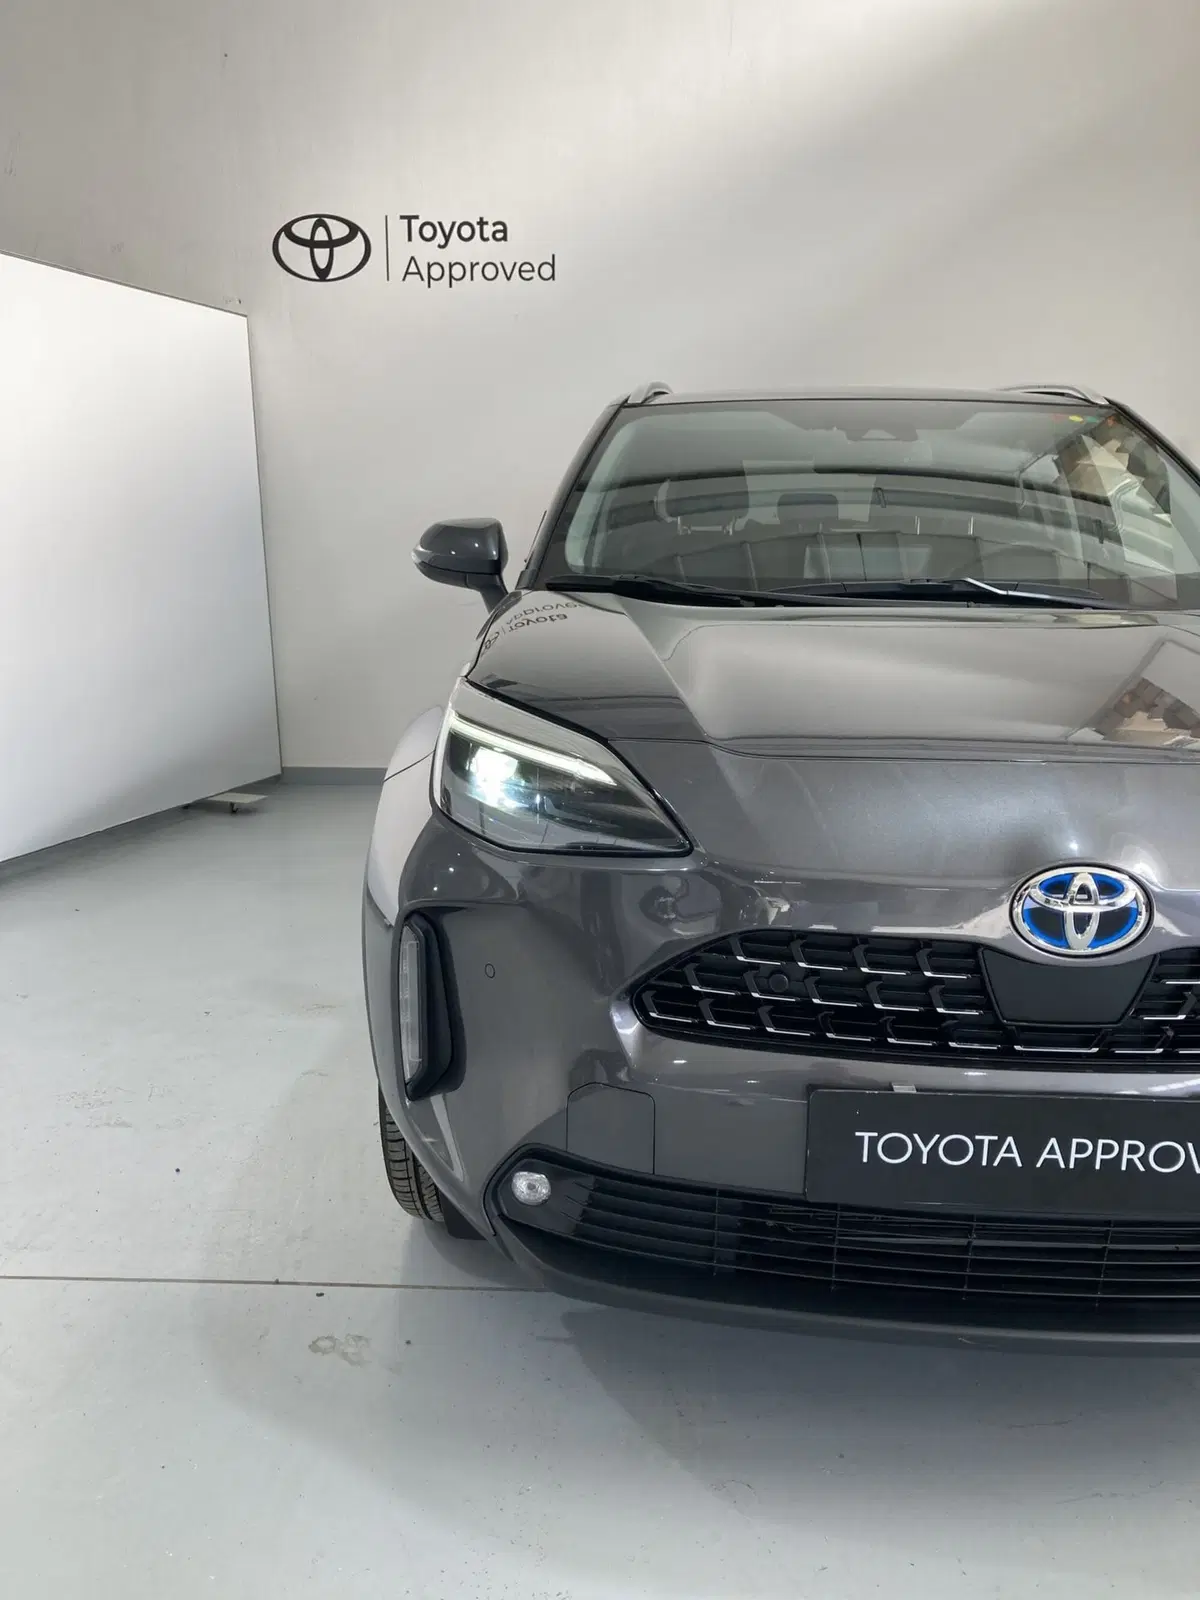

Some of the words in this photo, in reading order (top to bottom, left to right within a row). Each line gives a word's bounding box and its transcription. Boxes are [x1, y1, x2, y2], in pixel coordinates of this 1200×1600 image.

[399, 214, 509, 249] Toyota
[401, 253, 556, 289] Approved
[854, 1131, 1023, 1168] TOYOTA
